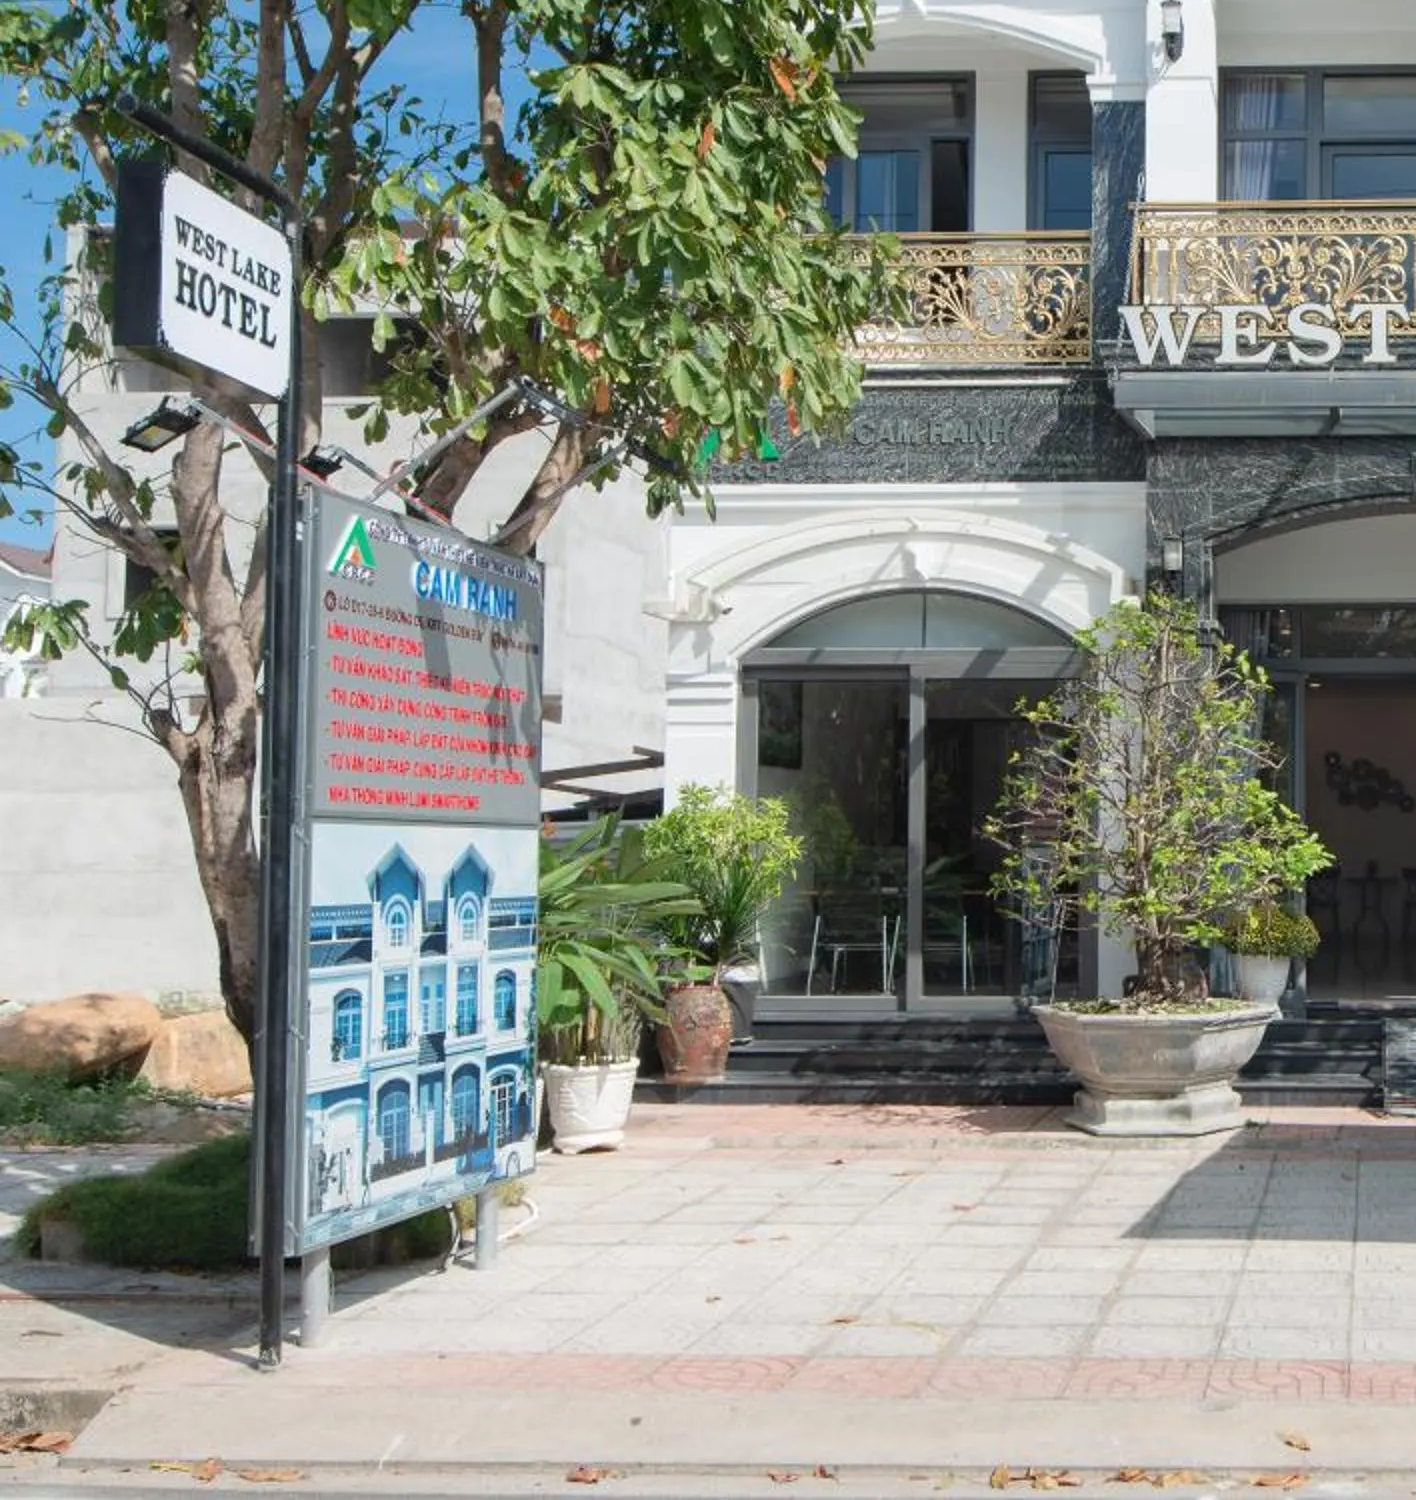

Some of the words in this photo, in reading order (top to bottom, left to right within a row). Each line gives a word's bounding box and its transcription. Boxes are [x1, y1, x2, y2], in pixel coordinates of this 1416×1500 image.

[175, 215, 227, 268] WEST
[232, 249, 281, 297] LAKE
[175, 259, 277, 349] HOTEL
[1118, 302, 1409, 366] WEST
[467, 576, 518, 621] RANH
